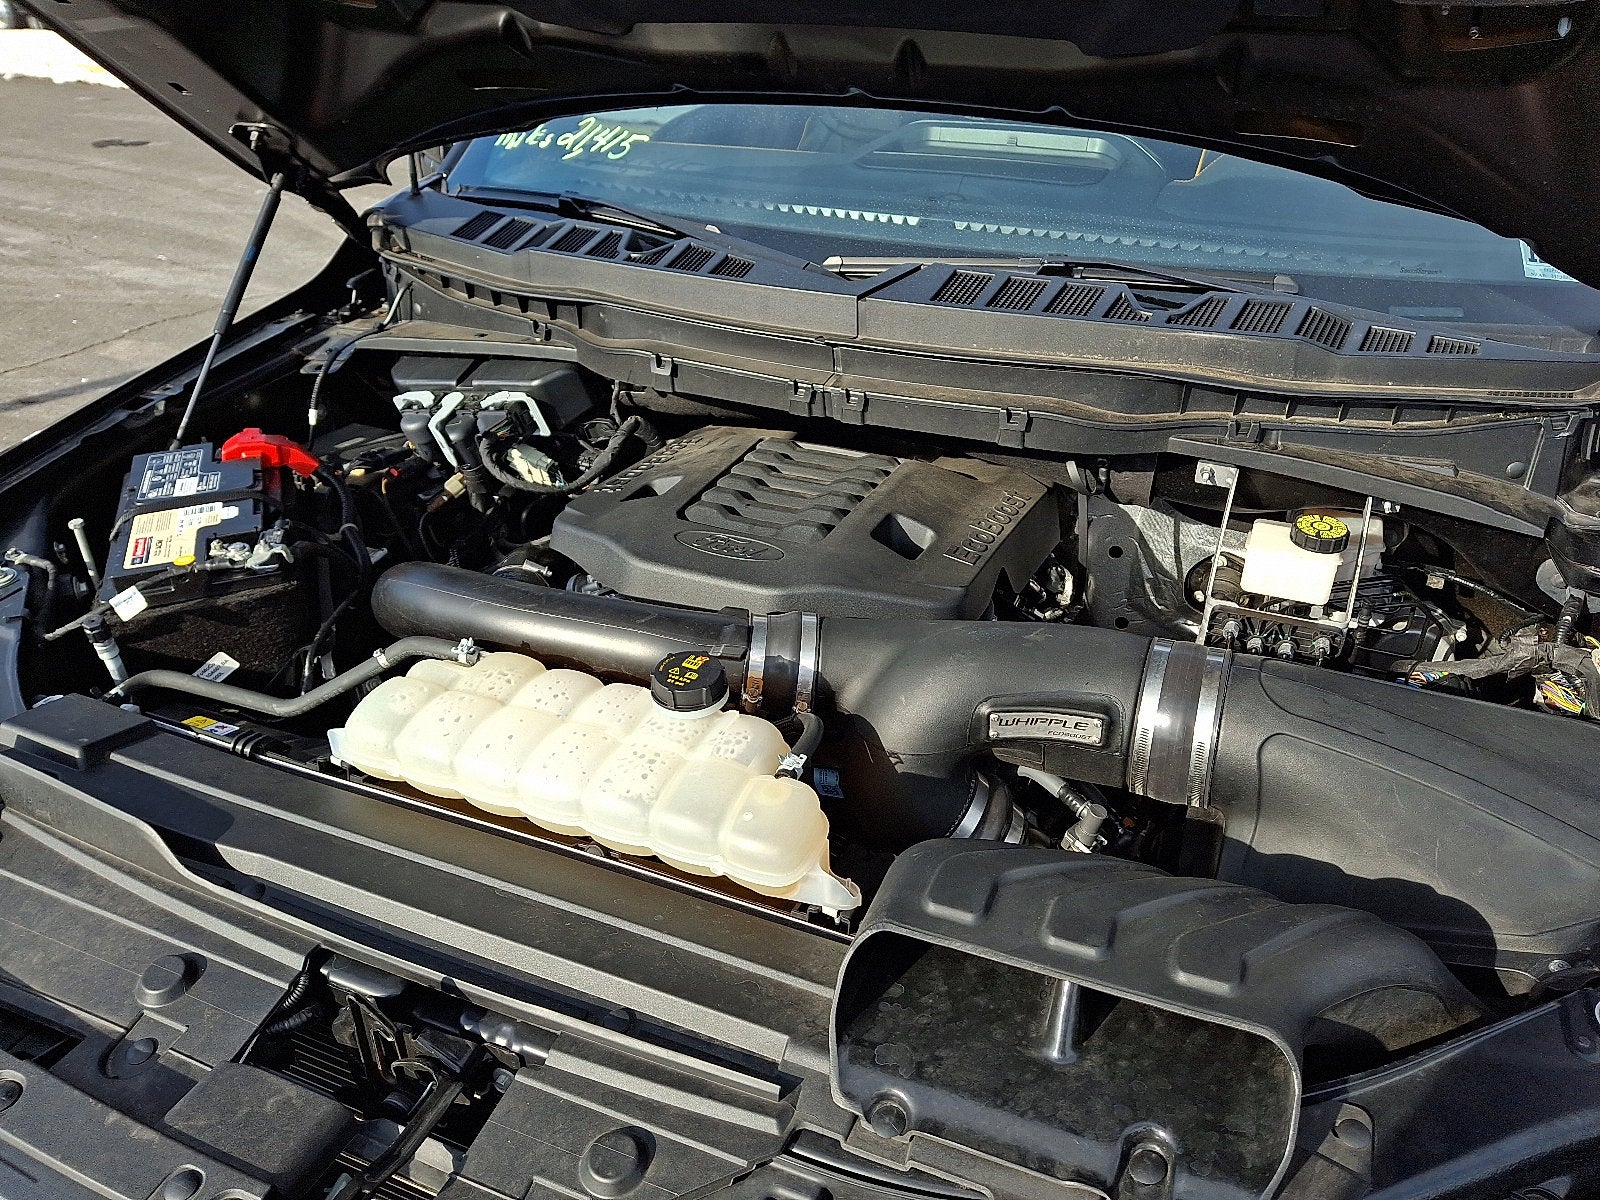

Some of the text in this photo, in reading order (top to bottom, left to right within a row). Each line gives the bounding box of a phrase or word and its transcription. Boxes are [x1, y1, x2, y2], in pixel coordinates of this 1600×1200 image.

[942, 489, 1033, 567] EcoBoost
[690, 533, 770, 559] Ford
[997, 716, 1090, 731] WHIPPLE
